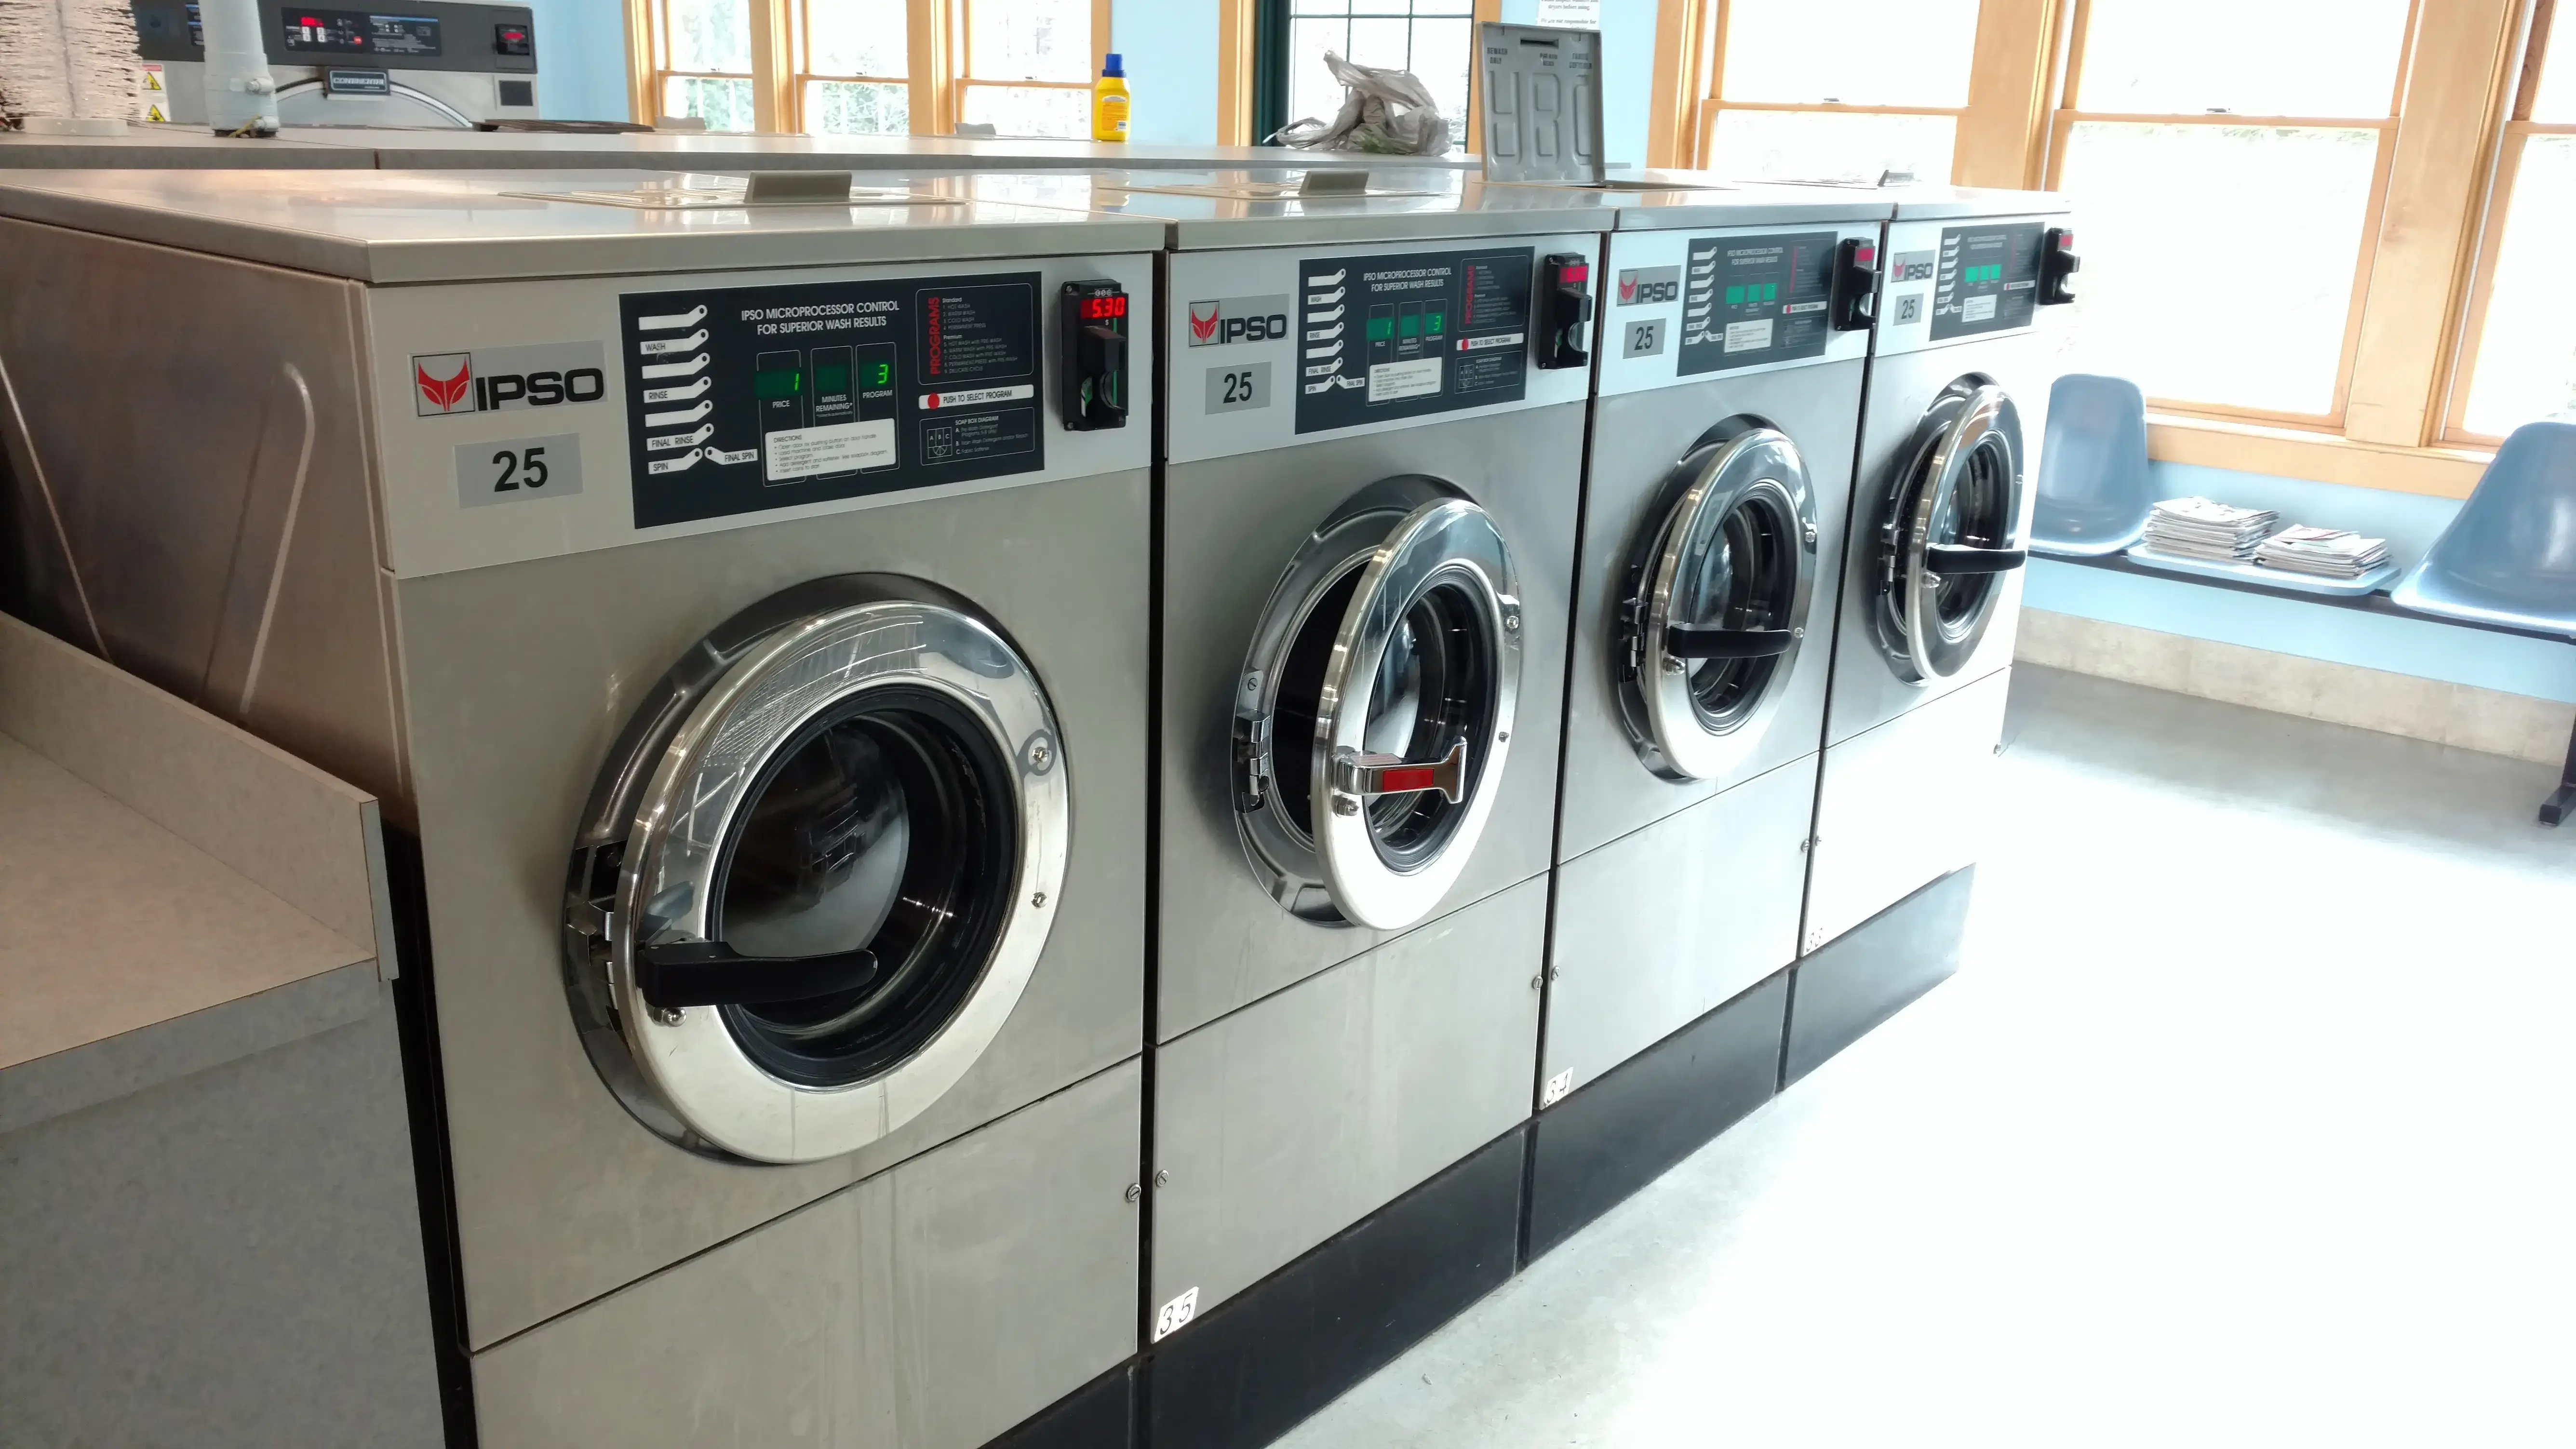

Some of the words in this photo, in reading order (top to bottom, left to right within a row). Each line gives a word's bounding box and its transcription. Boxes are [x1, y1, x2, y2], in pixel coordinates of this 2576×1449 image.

[1904, 262, 1933, 281] IPSO
[1637, 281, 1678, 304] IPSO
[741, 309, 764, 321] IPSO
[765, 303, 855, 319] MICROPROCESSOR
[856, 300, 899, 313] CONTROL
[1901, 299, 1915, 319] 25
[757, 324, 777, 335] FOR
[779, 321, 823, 334] SUPERIOR
[825, 318, 851, 330] WASH
[854, 316, 886, 328] RESULTS
[1220, 314, 1287, 344] IPSO
[1434, 315, 1441, 331] 3
[928, 297, 941, 375] PROGRAMS
[1634, 326, 1654, 350] 25
[645, 343, 666, 351] WASH
[794, 373, 799, 390] 1
[877, 364, 888, 384] 3
[476, 368, 604, 411] IPSO
[649, 391, 668, 400] RINSE
[863, 390, 892, 399] PROGRAM
[943, 396, 956, 404] PUSH
[966, 392, 984, 401] SELECT
[986, 390, 1012, 400] PROGRAM
[1223, 372, 1252, 403] 25
[772, 400, 790, 408] PRICE
[822, 394, 847, 403] MINUTES
[652, 439, 671, 448] FINAL
[675, 436, 694, 445] RINSE
[724, 453, 740, 462] FINAL
[741, 451, 754, 460] SPIN
[492, 447, 548, 492] 25
[653, 463, 669, 471] SPIN
[1160, 1293, 1193, 1335] 35
